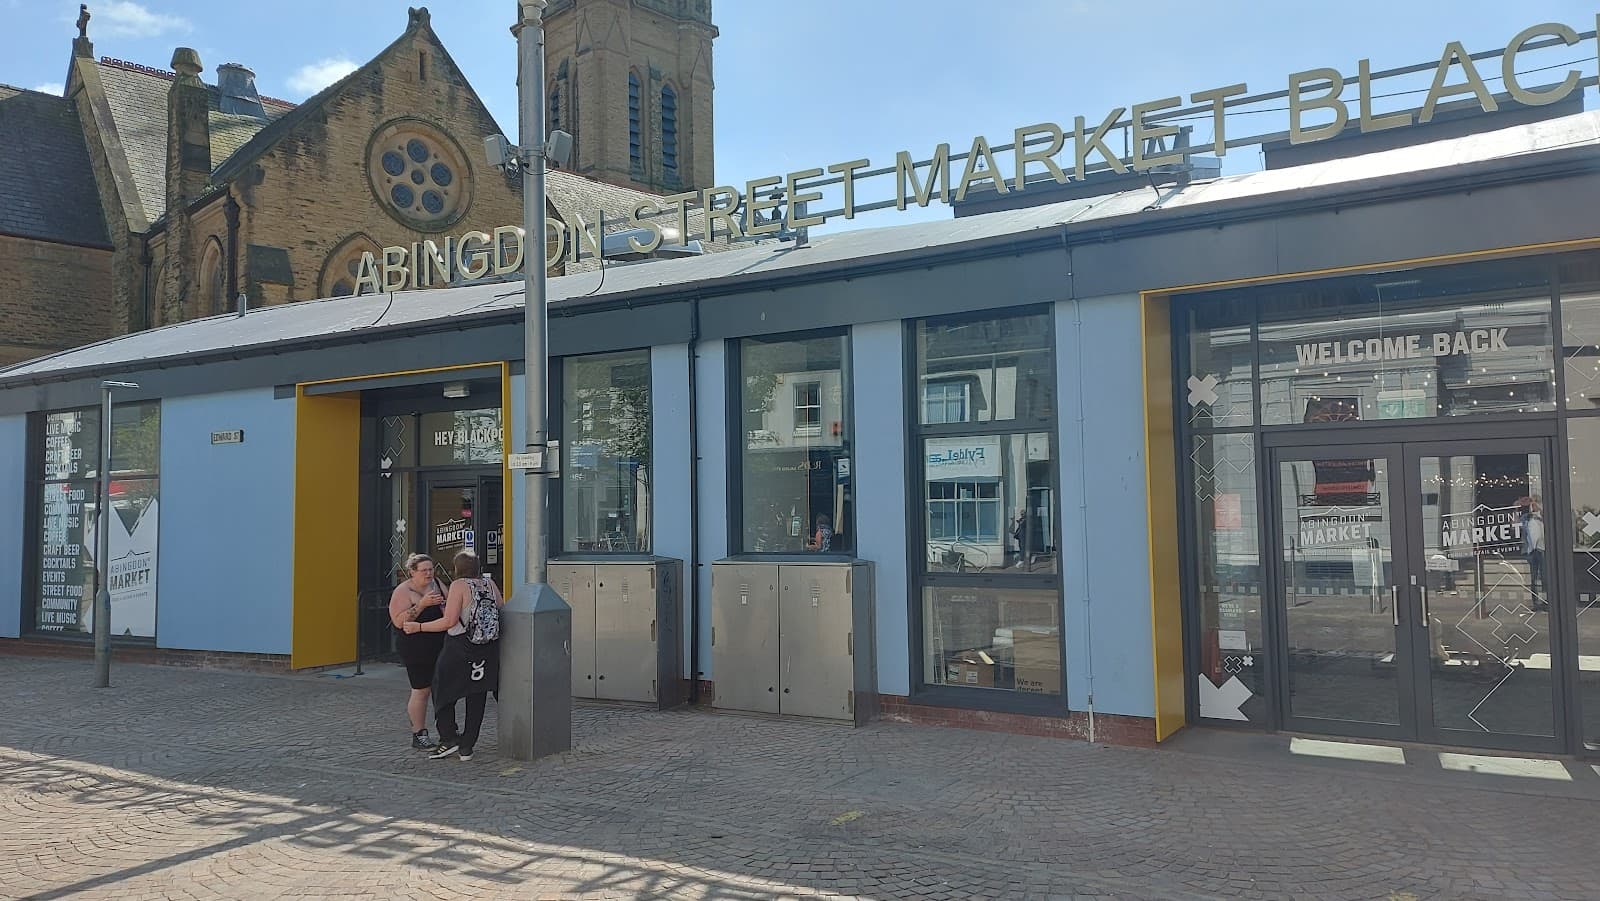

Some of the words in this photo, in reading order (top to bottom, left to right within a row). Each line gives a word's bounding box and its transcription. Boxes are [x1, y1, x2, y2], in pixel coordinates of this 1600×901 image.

[628, 158, 870, 253] STREET
[896, 82, 1248, 211] MARKET
[1288, 13, 1600, 145] BLAC
[1296, 334, 1421, 366] WELCOME
[1433, 327, 1509, 357] BACK
[46, 423, 59, 435] LIVE
[46, 436, 69, 448] COFFEE
[434, 430, 454, 446] HEY
[45, 462, 78, 474] COCKTAILS
[68, 489, 85, 501] FOOD
[1301, 513, 1365, 530] ABINGDON
[1442, 512, 1515, 530] ABINGDON
[436, 528, 466, 545] MARKET
[1300, 523, 1372, 546] MARKET
[1442, 522, 1523, 547] MARKET
[43, 544, 62, 555] CRAFT
[64, 543, 80, 556] BEER
[43, 557, 76, 569] COCKTAILS
[111, 559, 147, 574] ABINGDON
[42, 571, 66, 582] EVENTS
[110, 568, 151, 592] MARKET
[42, 584, 64, 596] STREET
[66, 585, 83, 597] FOOD
[41, 598, 78, 610] COMMUNITY
[41, 611, 55, 623] LIVE
[56, 612, 77, 625] MUSIC
